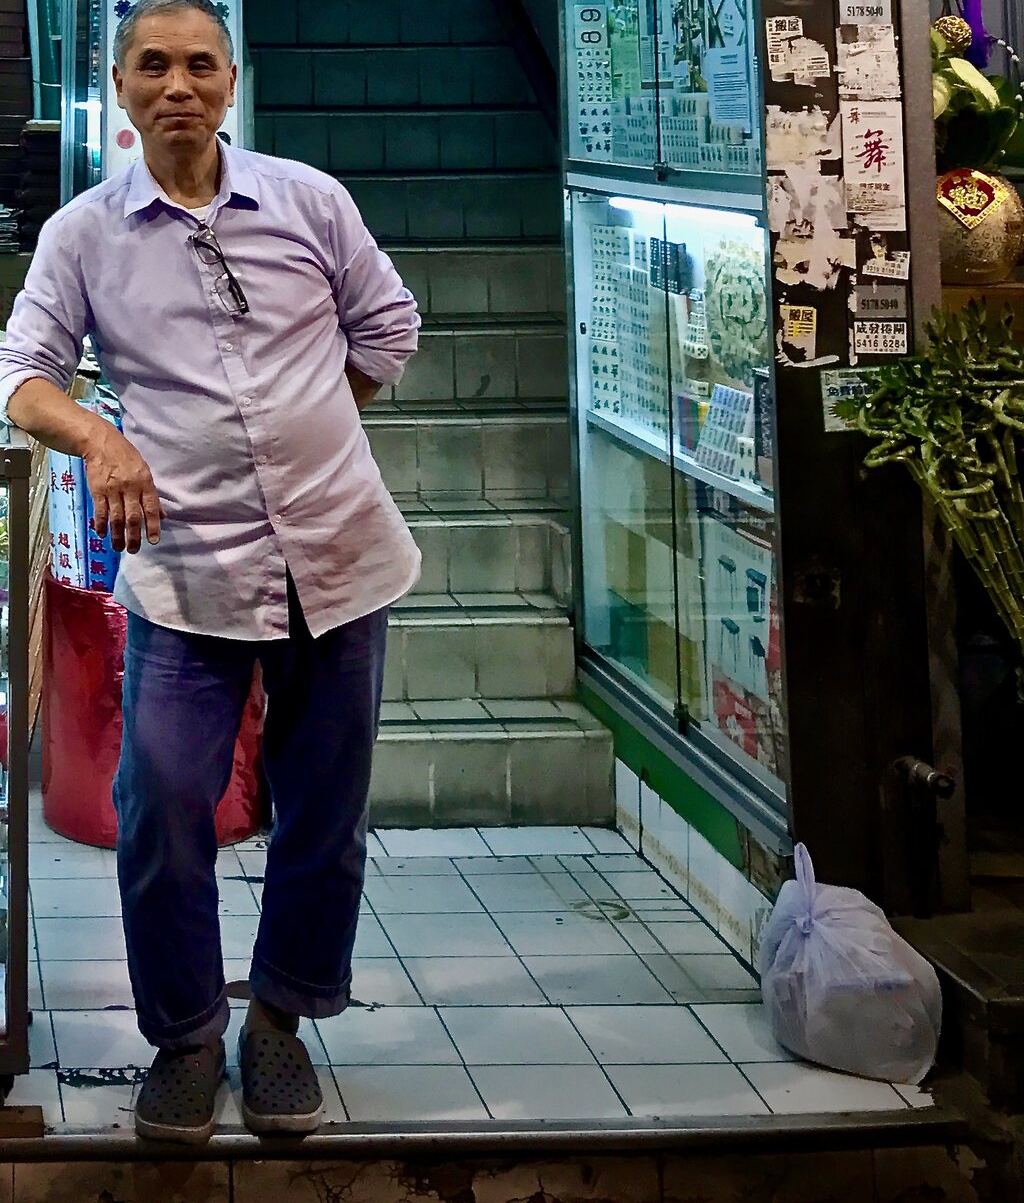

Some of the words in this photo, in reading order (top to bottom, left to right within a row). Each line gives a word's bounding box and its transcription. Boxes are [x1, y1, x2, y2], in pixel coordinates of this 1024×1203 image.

[847, 5, 865, 17] 5178
[856, 339, 879, 349] 5416
[883, 339, 906, 349] 6284
